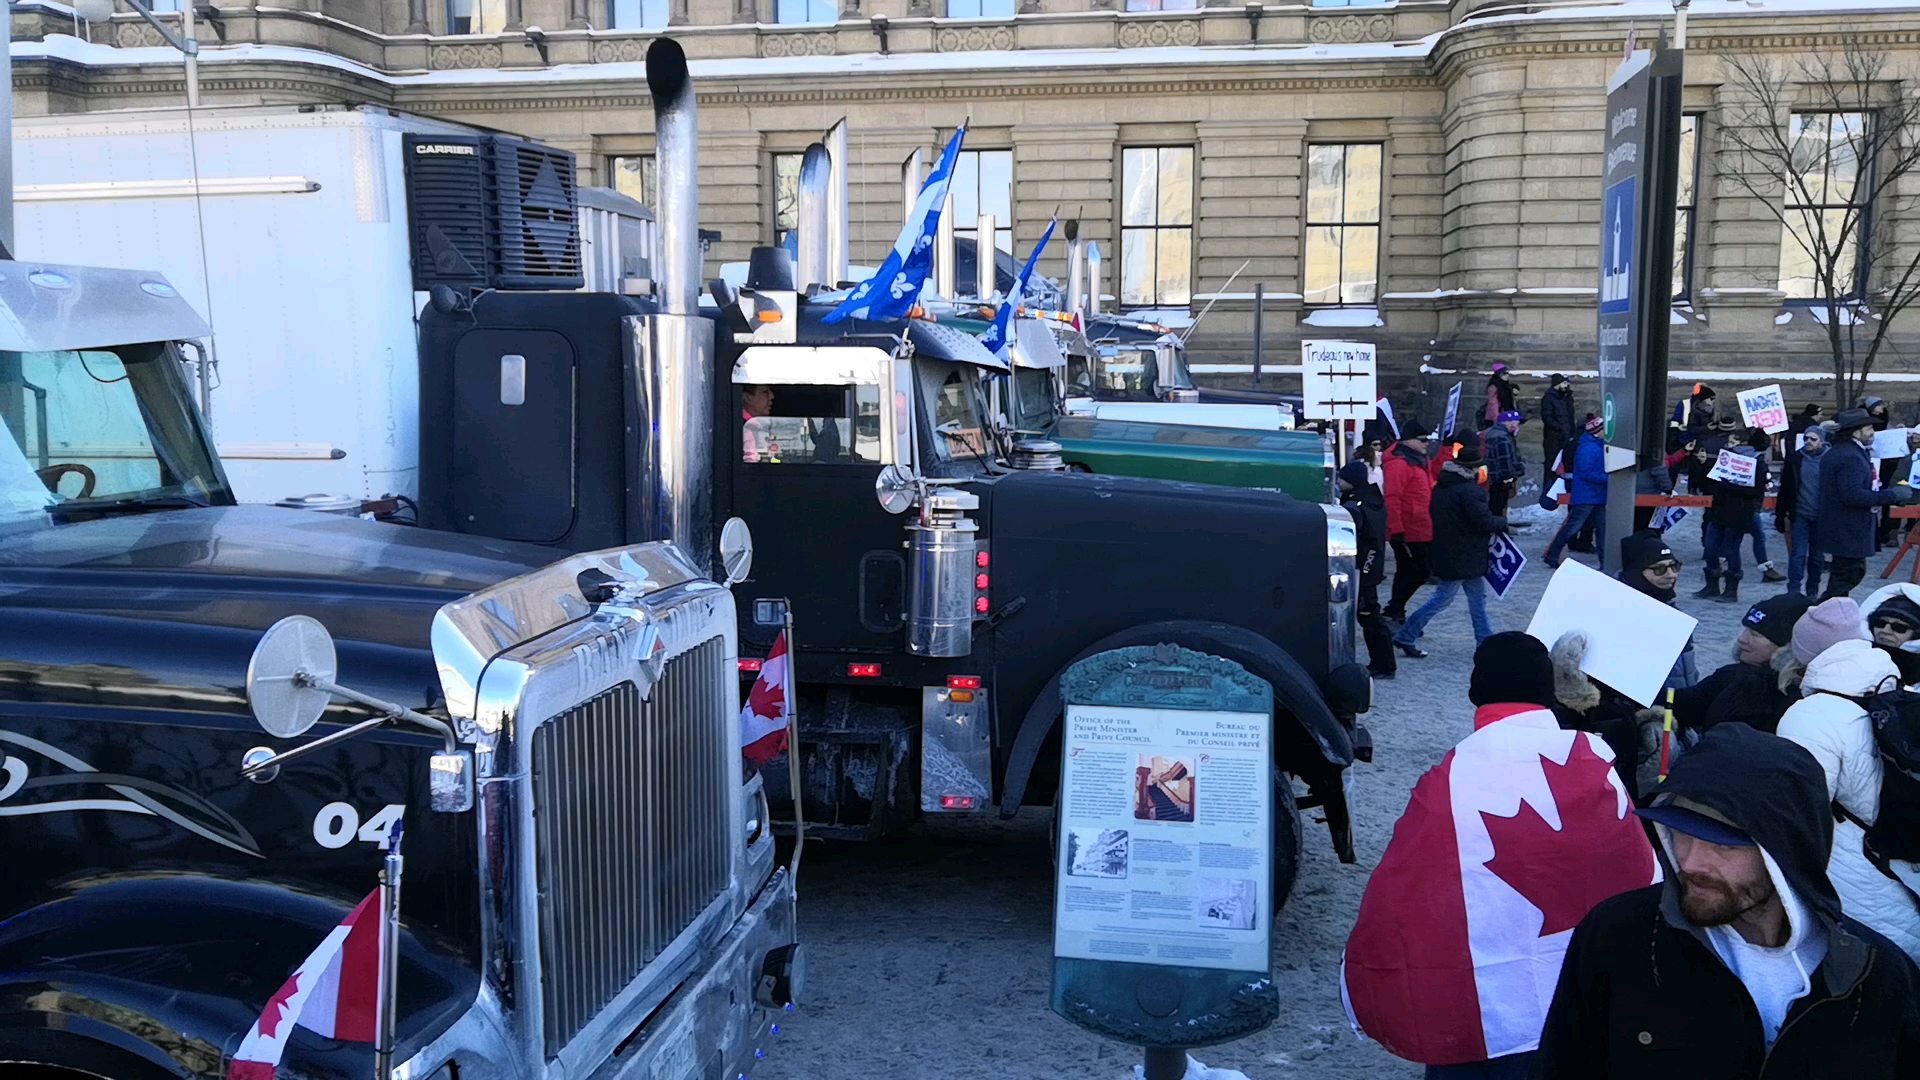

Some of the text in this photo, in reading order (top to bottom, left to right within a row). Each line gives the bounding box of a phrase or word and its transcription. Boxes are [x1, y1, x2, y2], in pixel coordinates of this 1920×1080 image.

[416, 145, 474, 155] CARRIER
[1604, 400, 1613, 435] P
[1074, 716, 1101, 724] OFFICE
[1074, 724, 1138, 733] PRIME MINISTER
[1216, 721, 1246, 730] BUREAU
[1091, 732, 1114, 741] PRIVY
[1115, 734, 1152, 743] COUNCIL
[1175, 728, 1209, 737] PREMIER
[1212, 731, 1248, 739] MINISTRE
[1201, 738, 1235, 747] CONSEIL
[1238, 740, 1260, 748] PRIVÉ
[313, 801, 406, 850] 04
